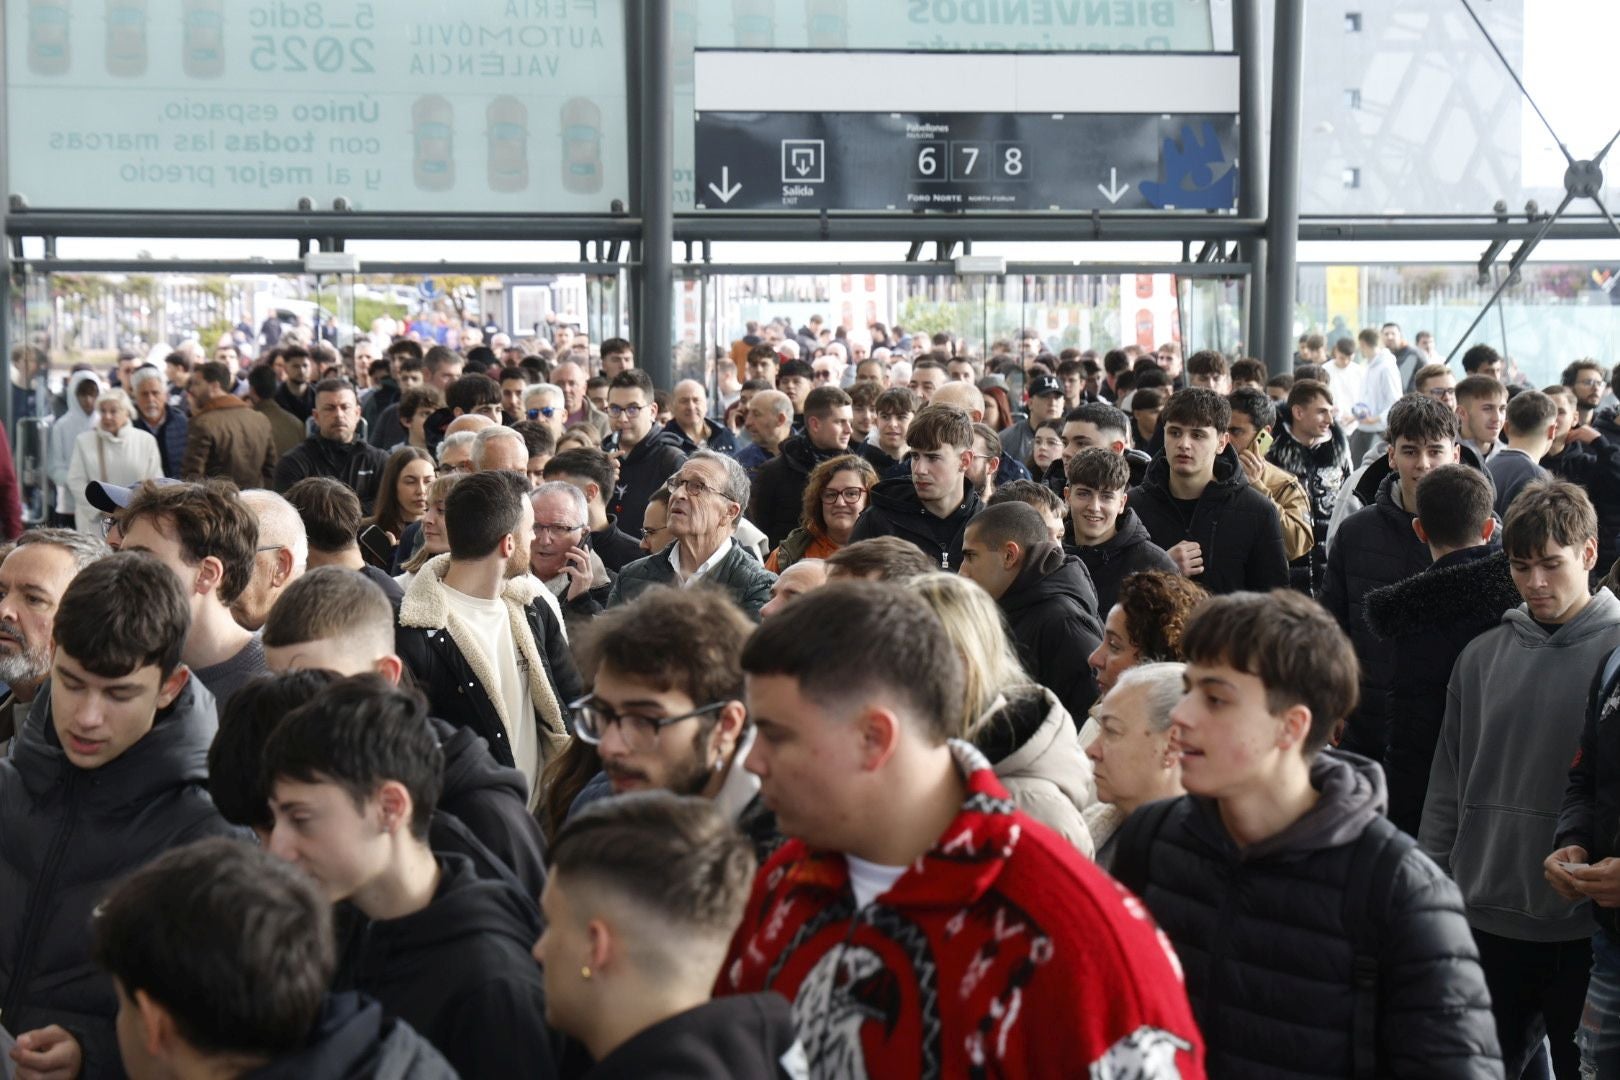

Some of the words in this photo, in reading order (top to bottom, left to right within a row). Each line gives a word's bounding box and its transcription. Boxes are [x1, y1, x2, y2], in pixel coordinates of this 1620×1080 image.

[906, 123, 950, 133] Pabellones
[917, 147, 937, 175] 6
[961, 147, 980, 175] 7
[1004, 147, 1023, 175] 8
[782, 184, 814, 197] Salida
[1043, 376, 1060, 389] LA
